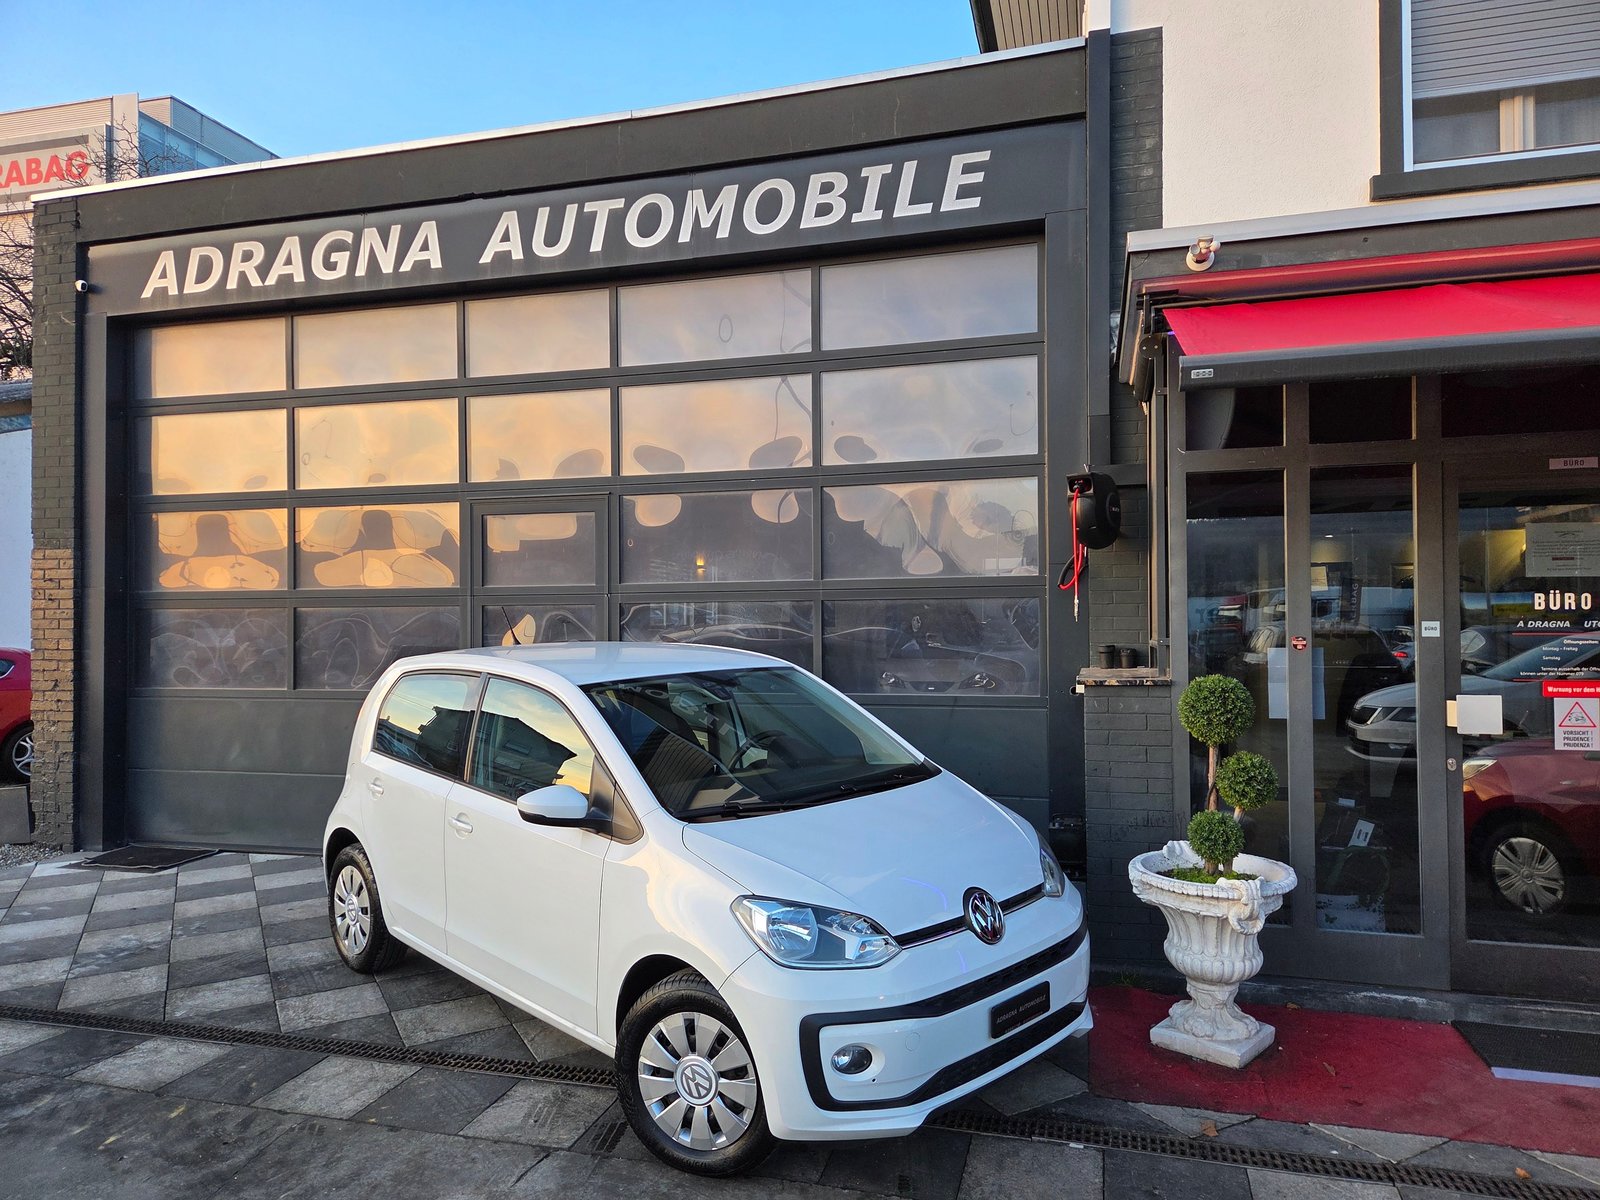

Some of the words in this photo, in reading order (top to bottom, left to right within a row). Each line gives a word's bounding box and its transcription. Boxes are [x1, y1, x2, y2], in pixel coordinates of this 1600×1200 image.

[140, 220, 443, 299] ADRAGNA
[479, 150, 992, 264] AUTOMOBILE
[1534, 590, 1592, 610] BÜRO
[1527, 620, 1571, 628] DRAGNA
[1583, 620, 1600, 628] UT
[1547, 686, 1573, 694] Warnung
